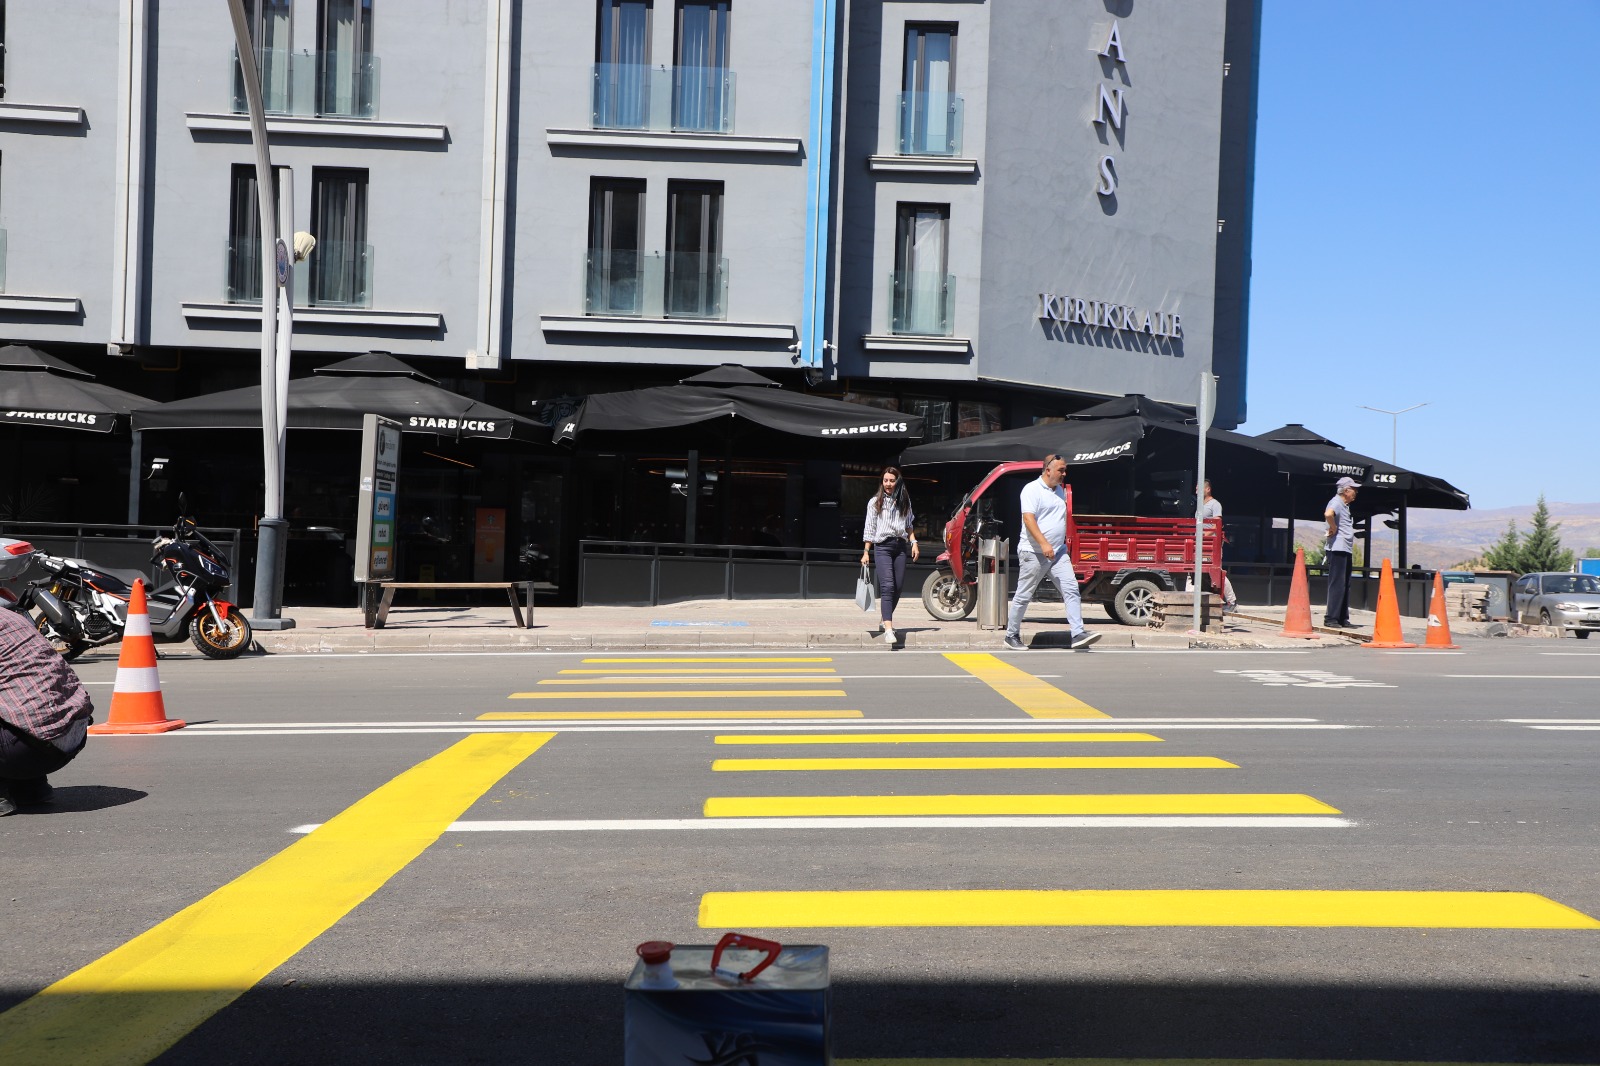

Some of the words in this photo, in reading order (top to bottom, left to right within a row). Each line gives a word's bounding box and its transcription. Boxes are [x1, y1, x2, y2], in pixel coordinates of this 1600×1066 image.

[1039, 293, 1183, 339] KIRIKKALE
[821, 422, 908, 435] STARBUCKS
[1073, 441, 1132, 461] STARBUCKS
[1322, 462, 1365, 477] STARBUCKS
